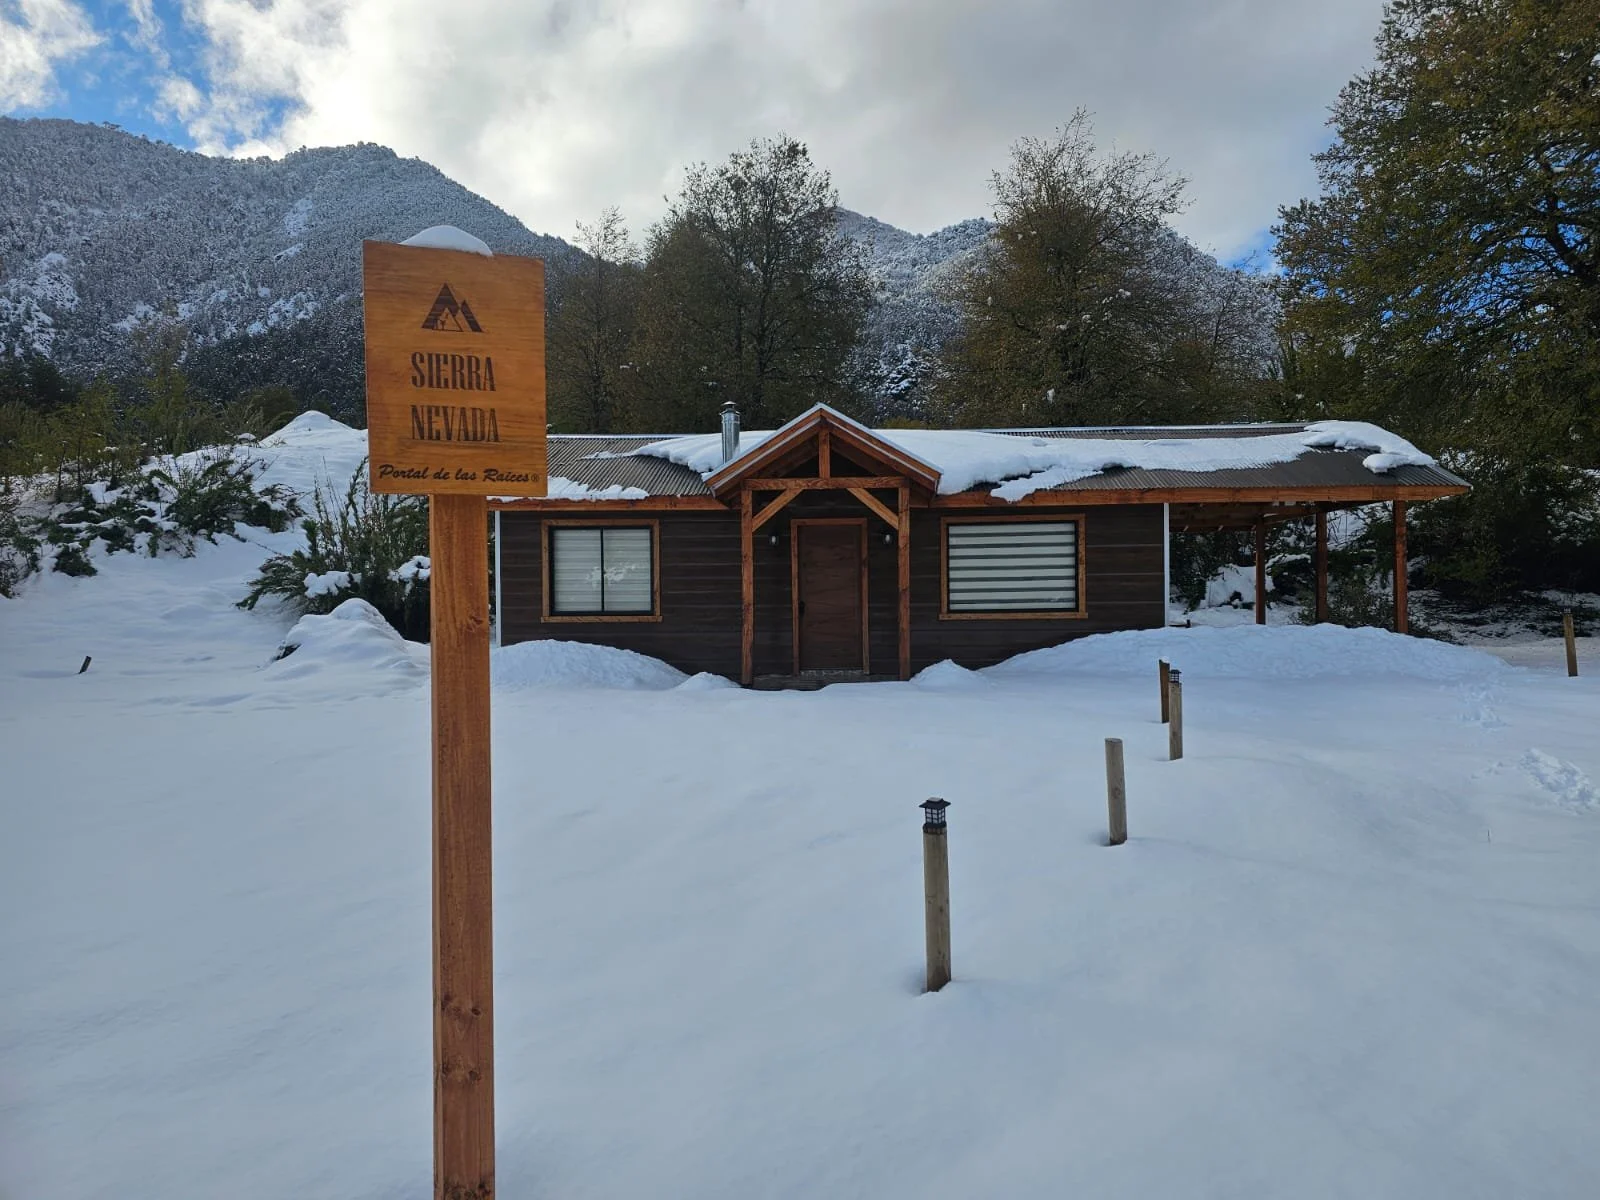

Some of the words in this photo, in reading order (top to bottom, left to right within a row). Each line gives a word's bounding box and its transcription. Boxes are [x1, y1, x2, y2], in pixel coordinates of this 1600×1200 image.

[411, 352, 496, 392] SIERRA
[410, 405, 500, 442] NEVADA
[379, 464, 429, 480] Portal
[433, 468, 450, 481] de
[455, 468, 477, 481] las
